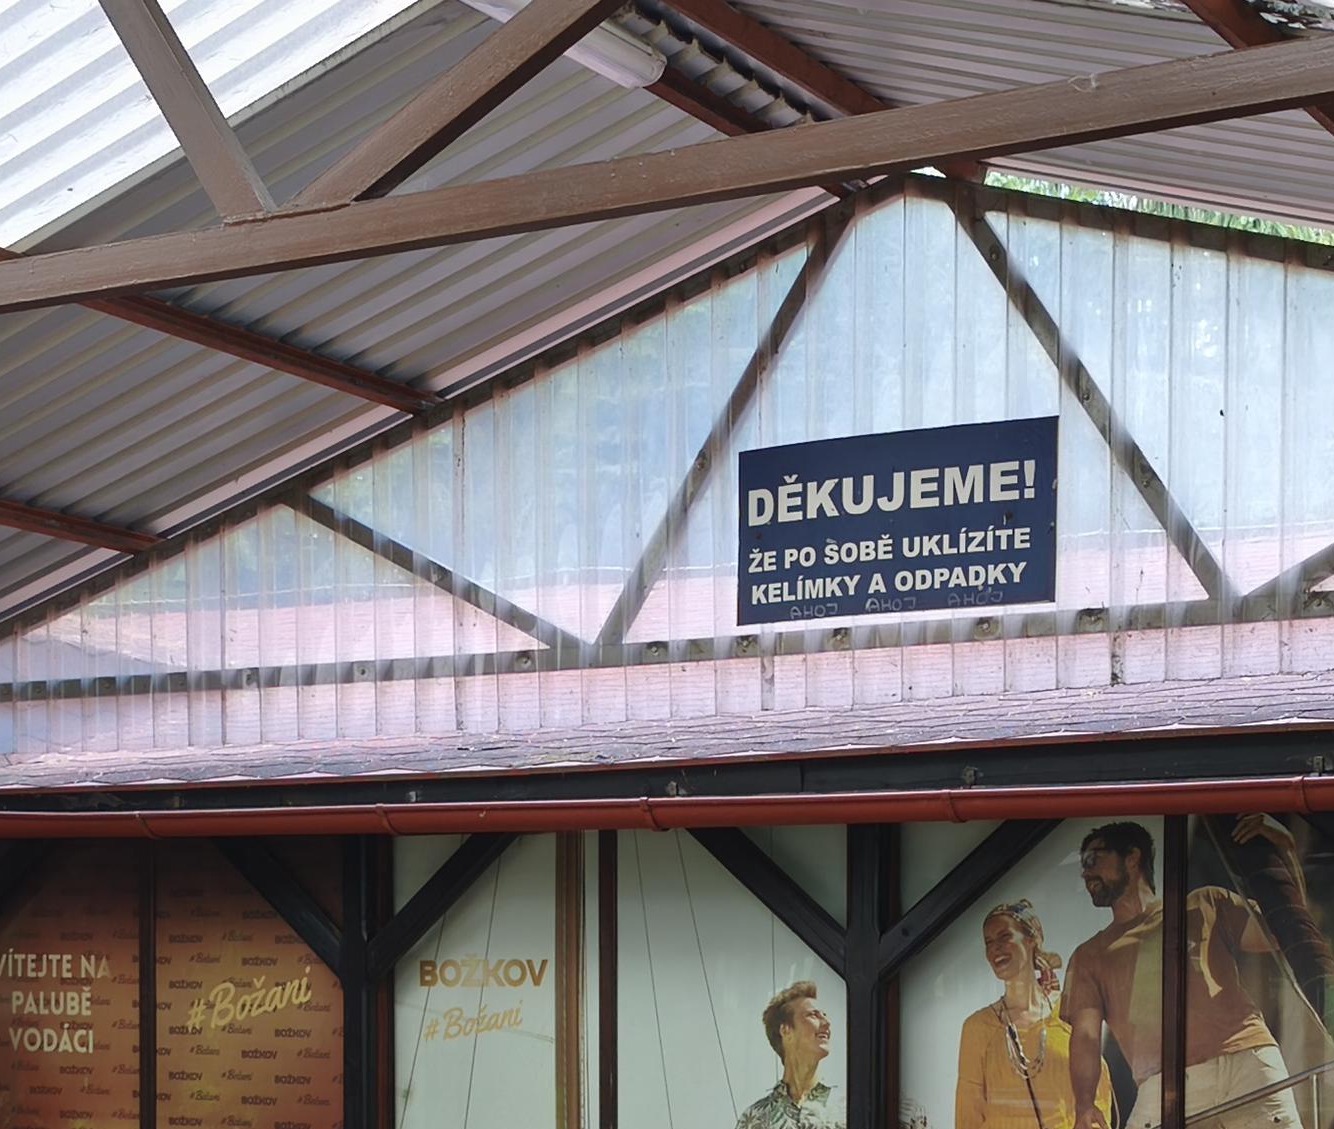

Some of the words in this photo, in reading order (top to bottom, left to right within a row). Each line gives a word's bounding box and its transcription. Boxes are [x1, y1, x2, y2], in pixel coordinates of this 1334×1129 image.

[747, 458, 1037, 528] DĚKUJEME!
[748, 547, 777, 574] ŽE
[784, 546, 817, 569] PO
[902, 526, 1032, 558] UKLÍZÍTE
[751, 574, 861, 606] KELÍMKY
[868, 573, 888, 594] A
[894, 561, 1028, 593] ODPADKY
[80, 953, 112, 979] NA
[419, 952, 549, 988] BOŽKOV
[11, 986, 92, 1016] PALUBĚ
[185, 964, 313, 1033] #Božani
[8, 1023, 95, 1055] VODÁCI
[423, 999, 524, 1042] #Božani
